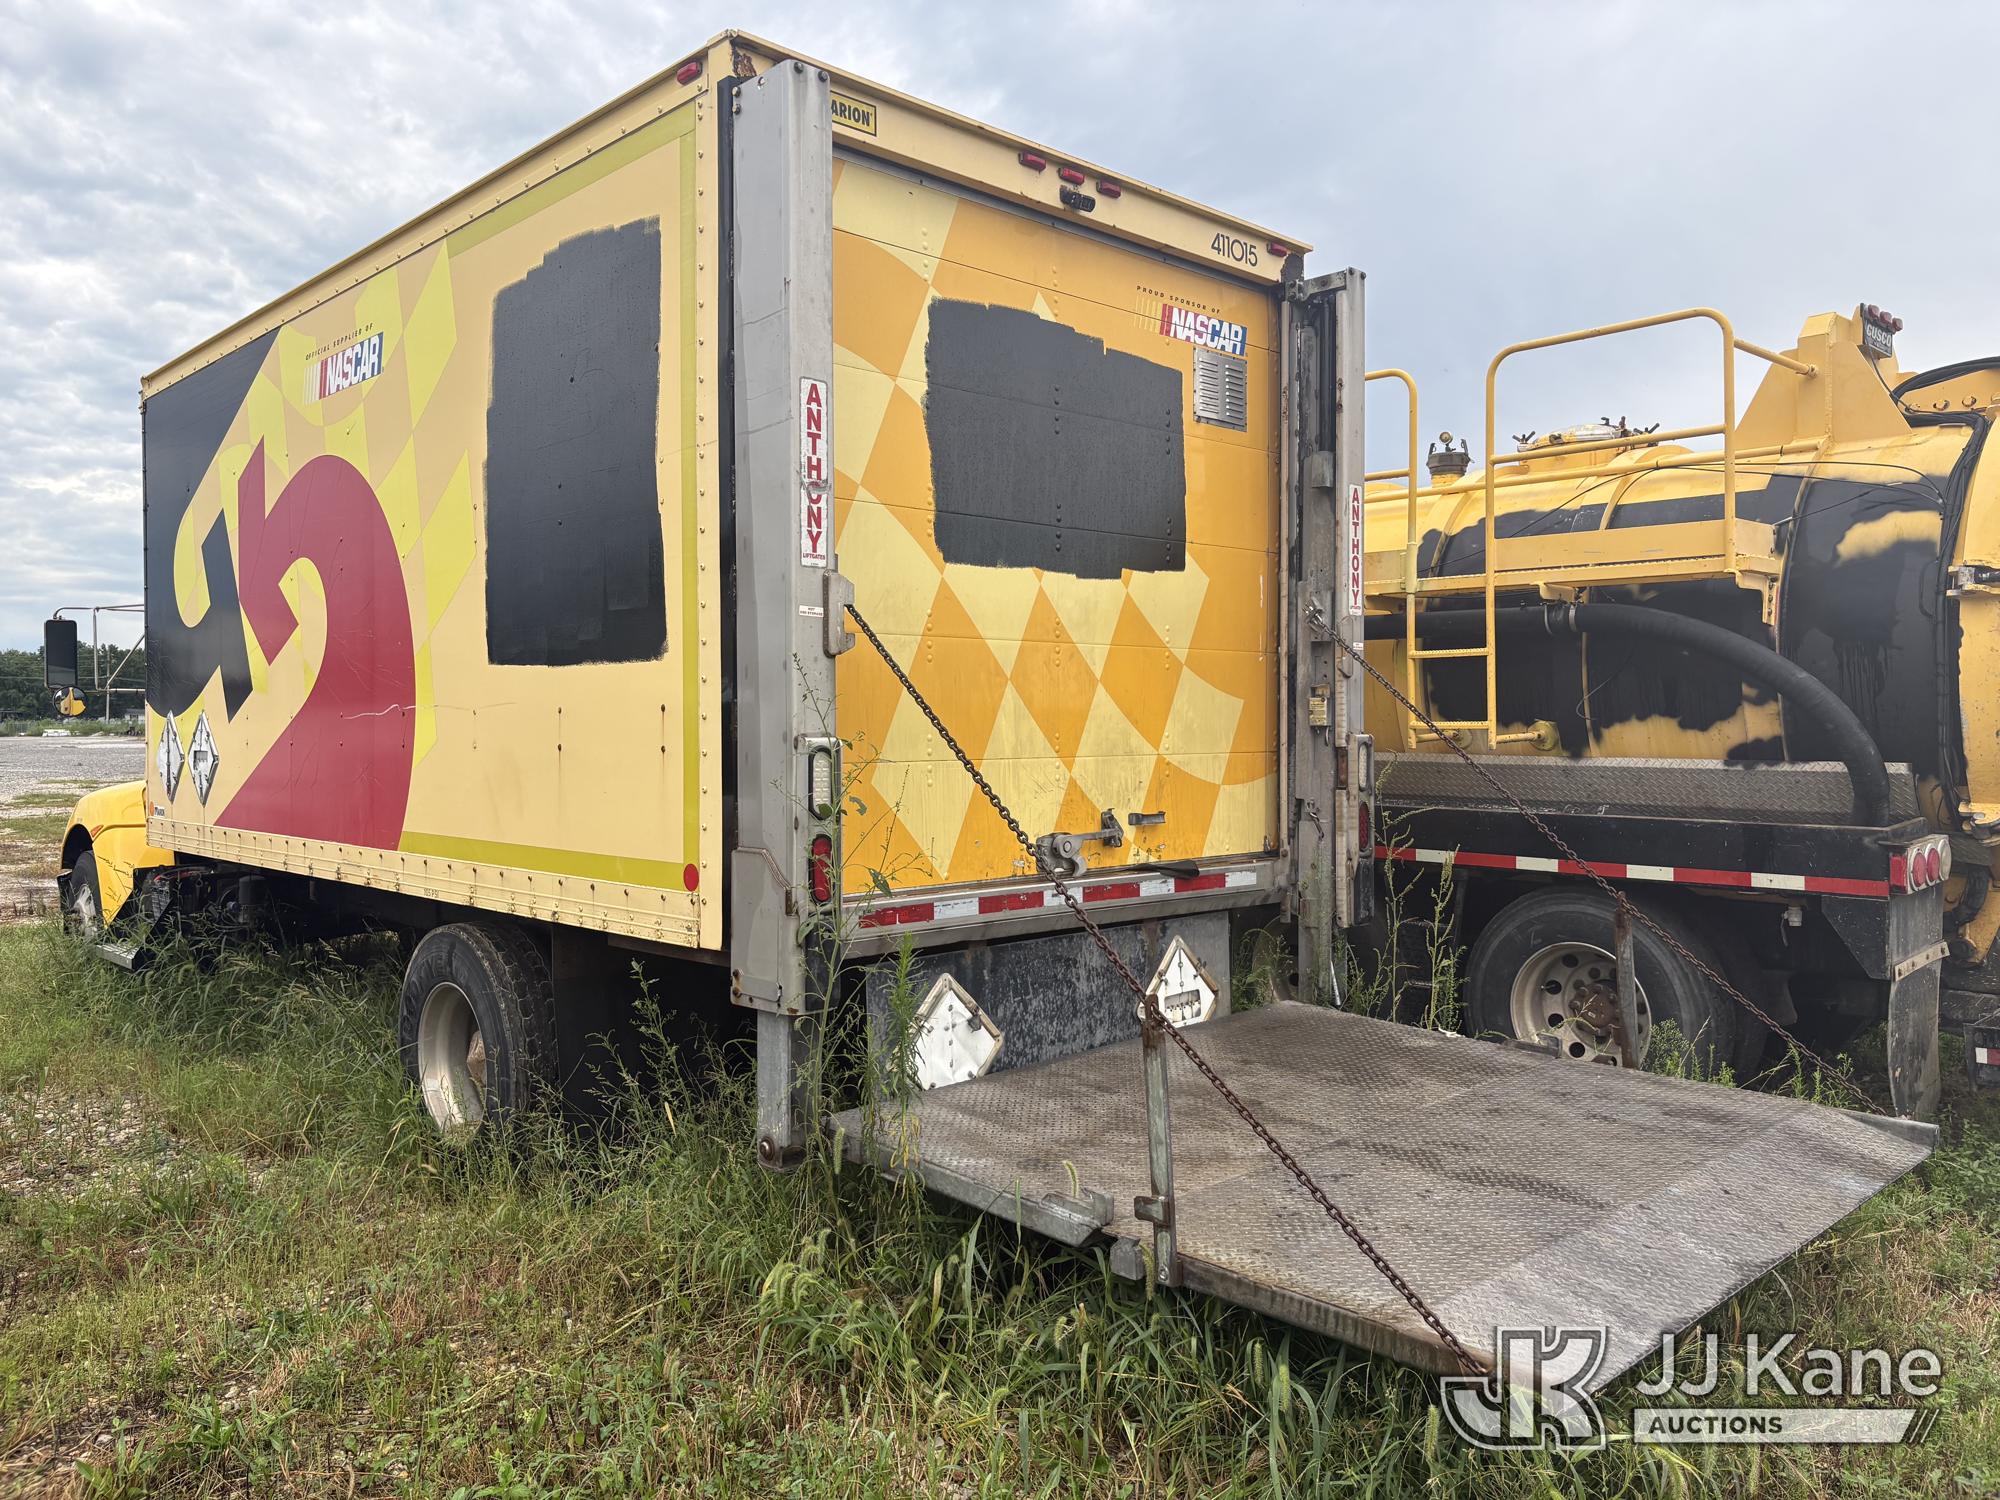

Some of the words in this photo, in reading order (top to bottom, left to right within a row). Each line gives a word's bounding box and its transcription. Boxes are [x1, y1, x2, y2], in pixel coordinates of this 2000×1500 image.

[831, 100, 870, 127] ARION
[1211, 233, 1258, 267] 411015
[1136, 285, 1165, 298] PROUD
[1170, 295, 1207, 310] SPONSOR
[1211, 307, 1221, 315] OF
[305, 344, 331, 361] OFFICIAL
[365, 322, 374, 332] OF
[1169, 307, 1243, 355] NASCAR
[1866, 324, 1892, 347] CUSCO
[325, 334, 380, 396] NASCAR
[806, 383, 822, 553] ANTHONY
[1352, 488, 1360, 606] ANTHONY
